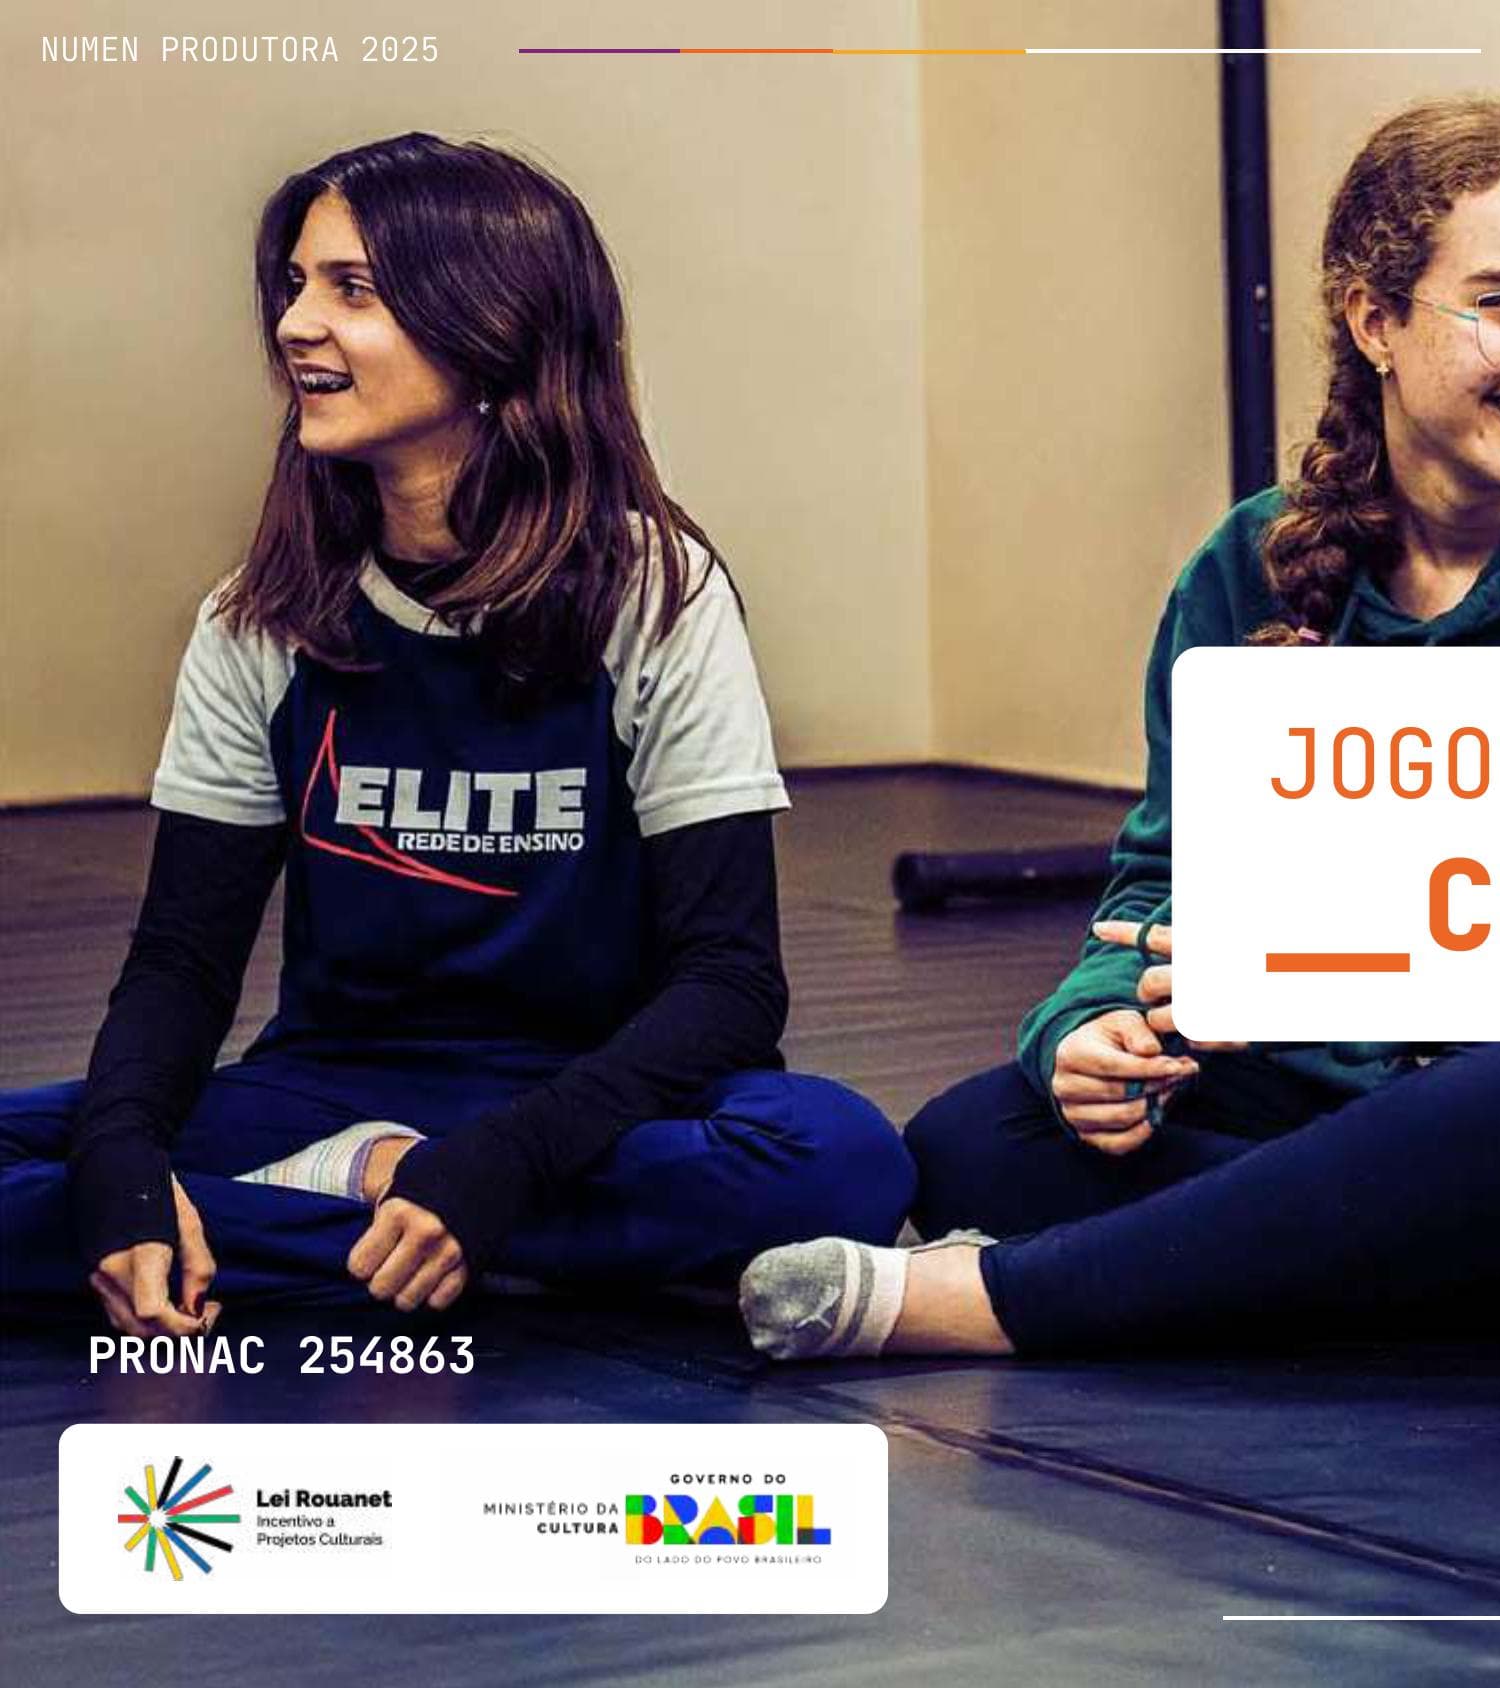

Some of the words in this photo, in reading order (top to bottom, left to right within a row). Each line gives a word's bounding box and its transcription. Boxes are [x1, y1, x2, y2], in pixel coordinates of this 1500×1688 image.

[335, 765, 587, 832] ELITE
[397, 832, 461, 851] REDE
[463, 834, 495, 853] DE
[500, 832, 584, 853] ENSINO
